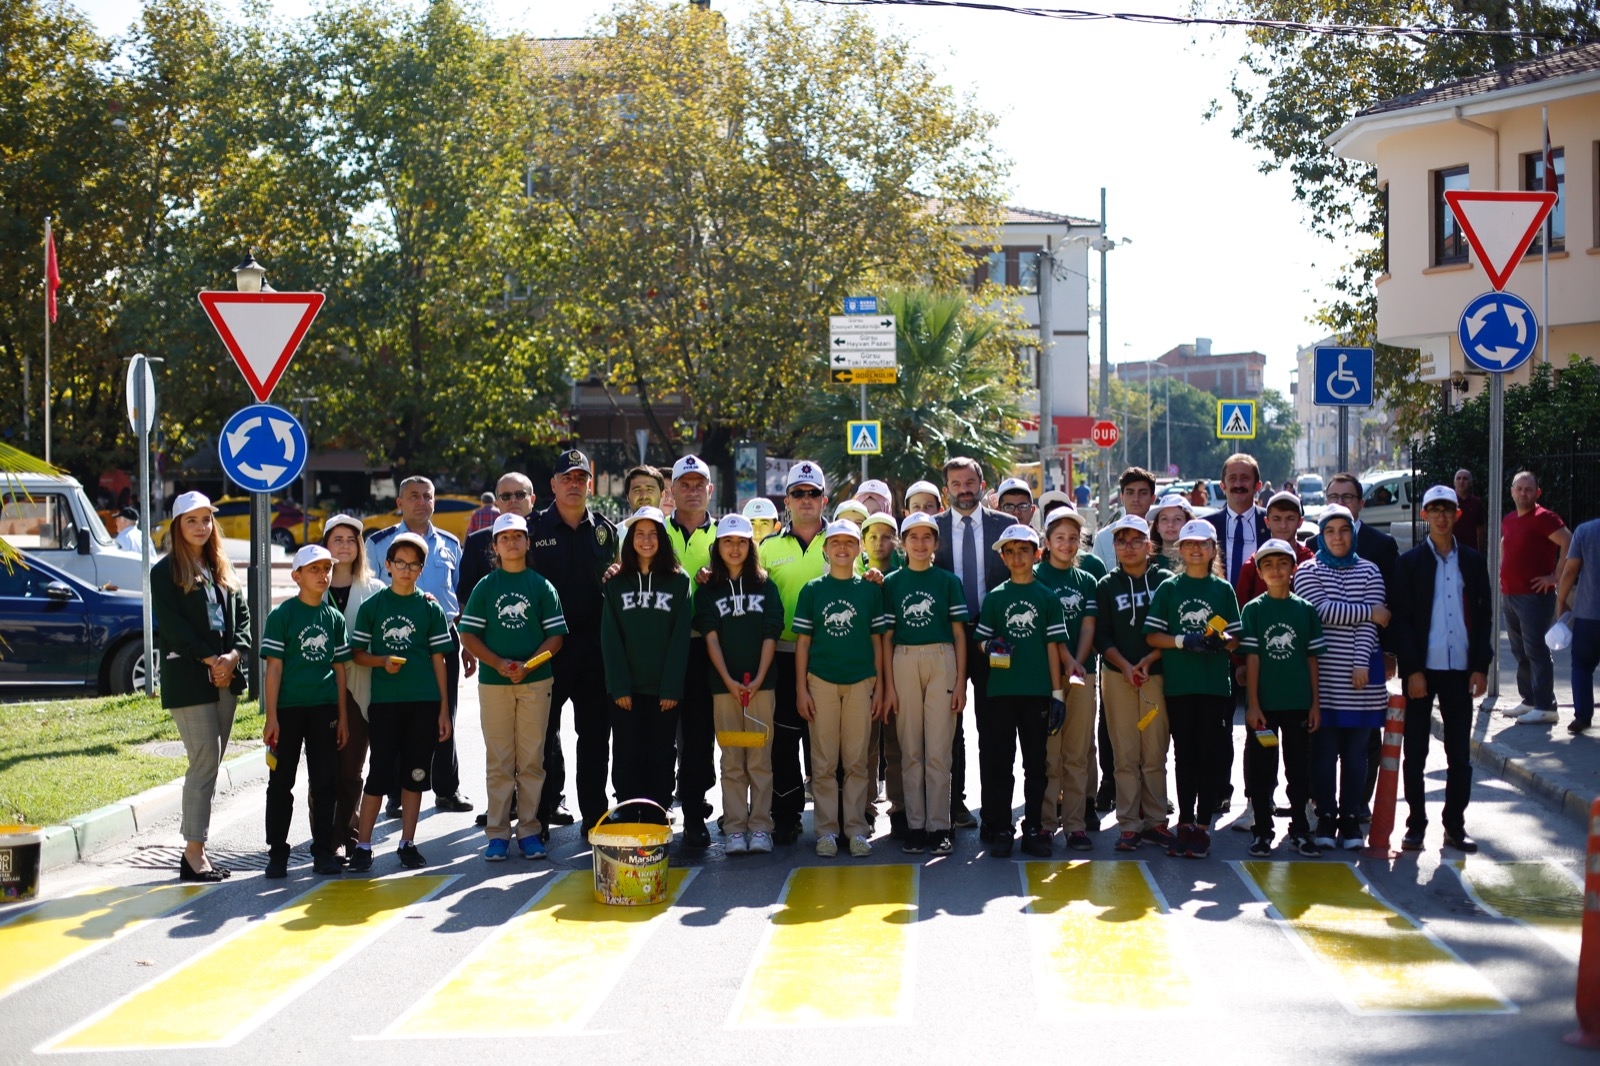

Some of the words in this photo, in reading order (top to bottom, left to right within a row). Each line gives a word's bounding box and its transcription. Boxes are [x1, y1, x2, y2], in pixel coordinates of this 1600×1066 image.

[1094, 429, 1117, 440] DUR
[621, 591, 673, 612] ETK
[628, 853, 664, 864] Marshall
